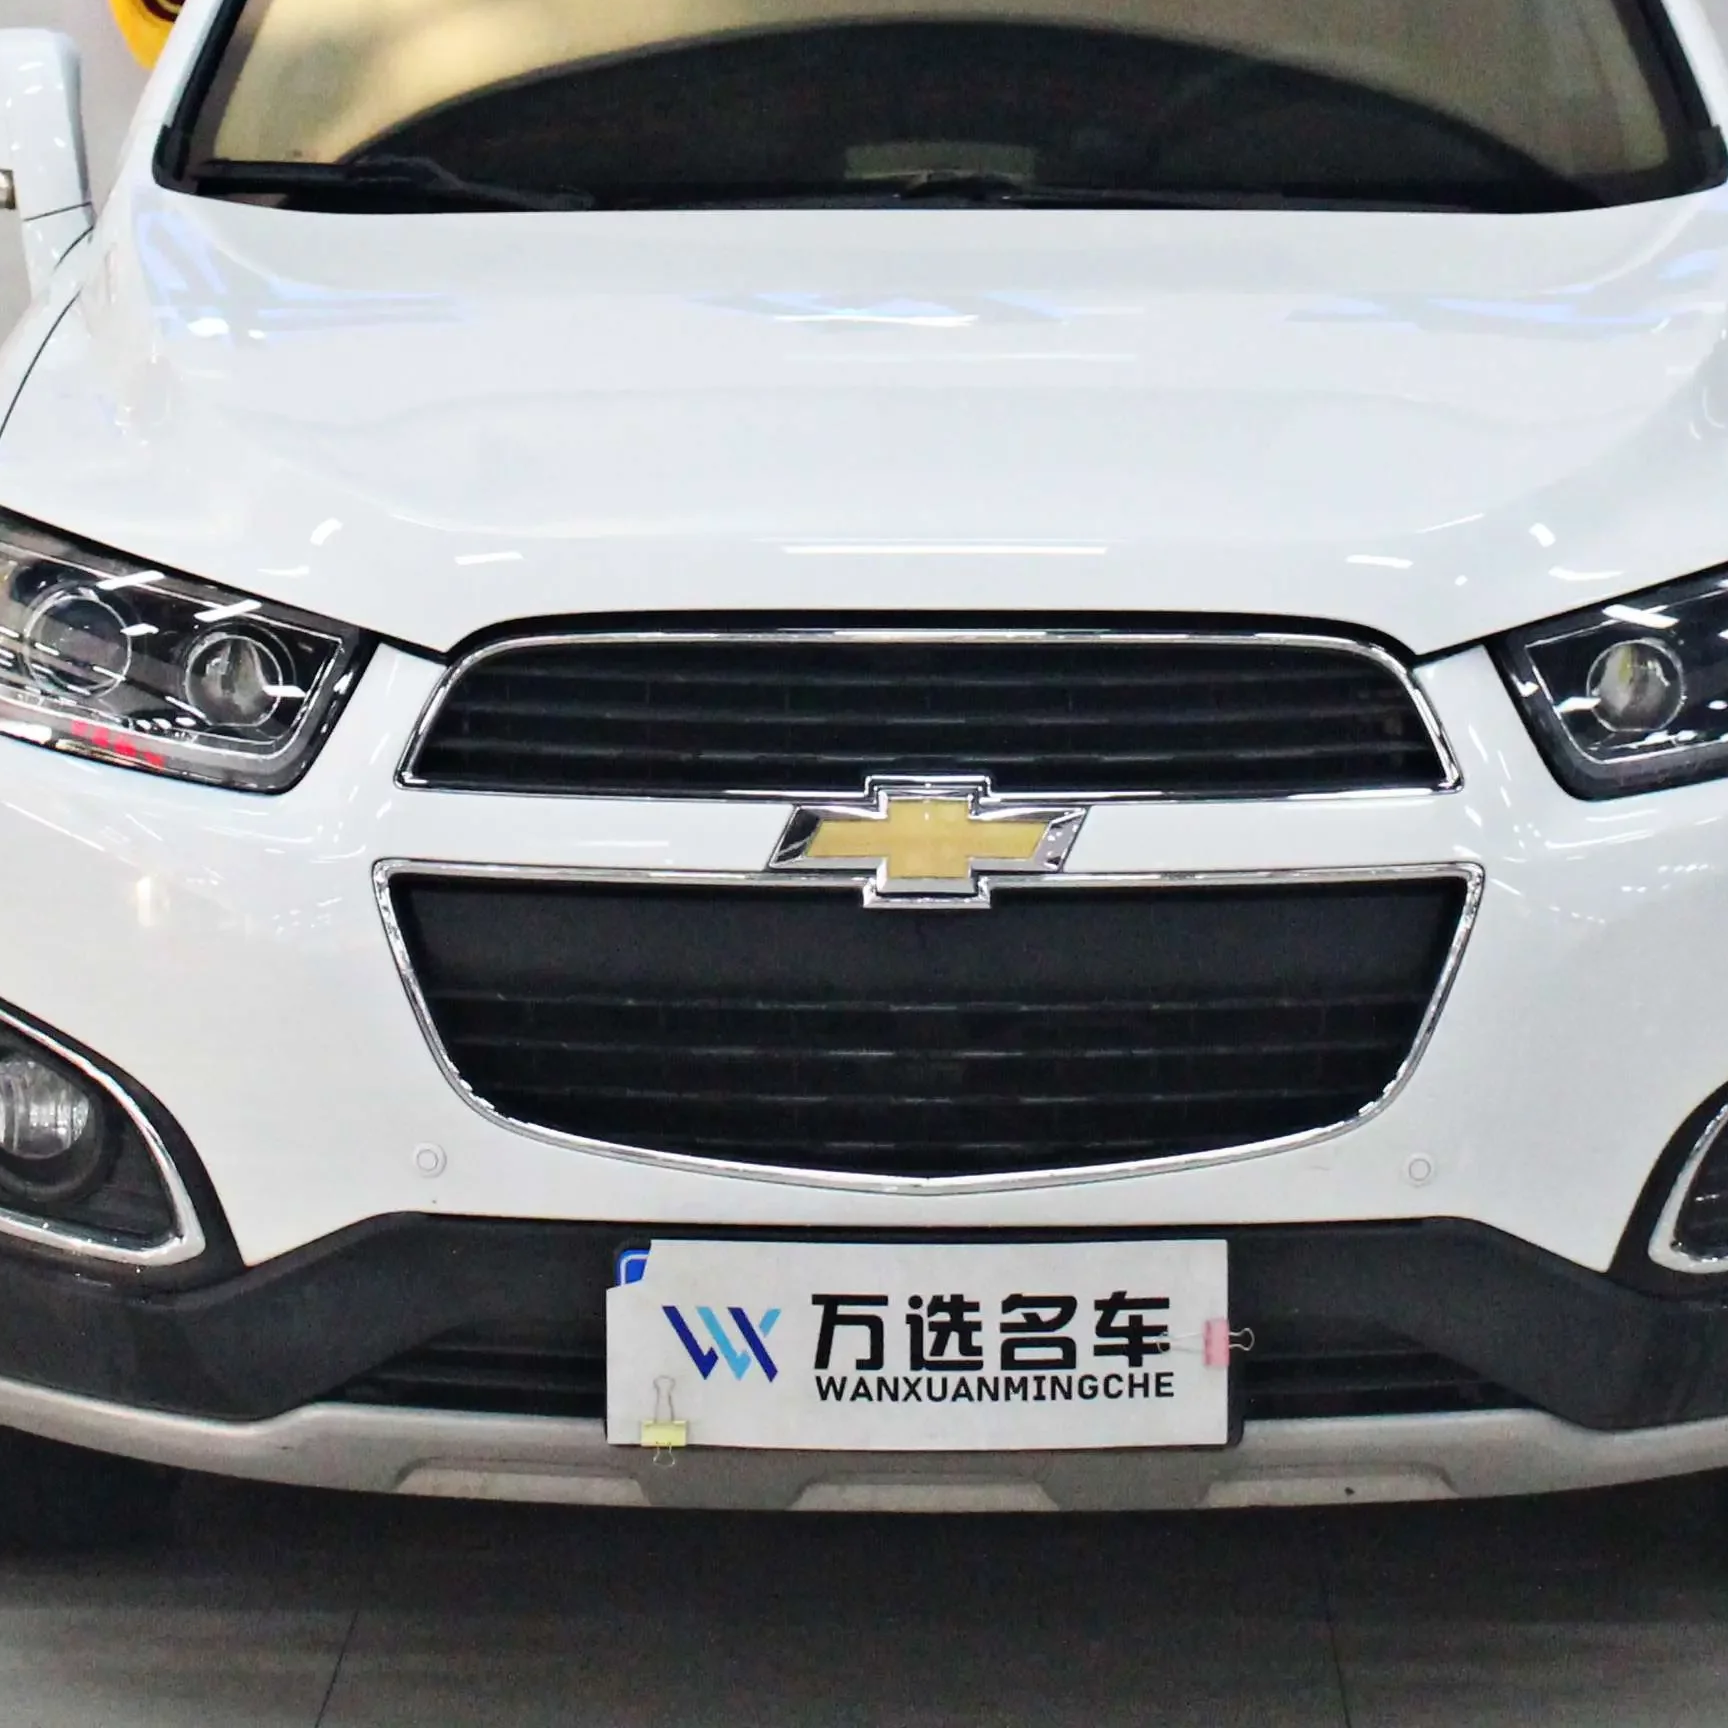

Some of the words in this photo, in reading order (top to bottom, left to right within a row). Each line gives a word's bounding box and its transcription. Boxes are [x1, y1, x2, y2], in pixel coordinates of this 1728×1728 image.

[811, 1290, 1171, 1371] 万选名车
[814, 1371, 1175, 1403] WANXUANMINGCHE
